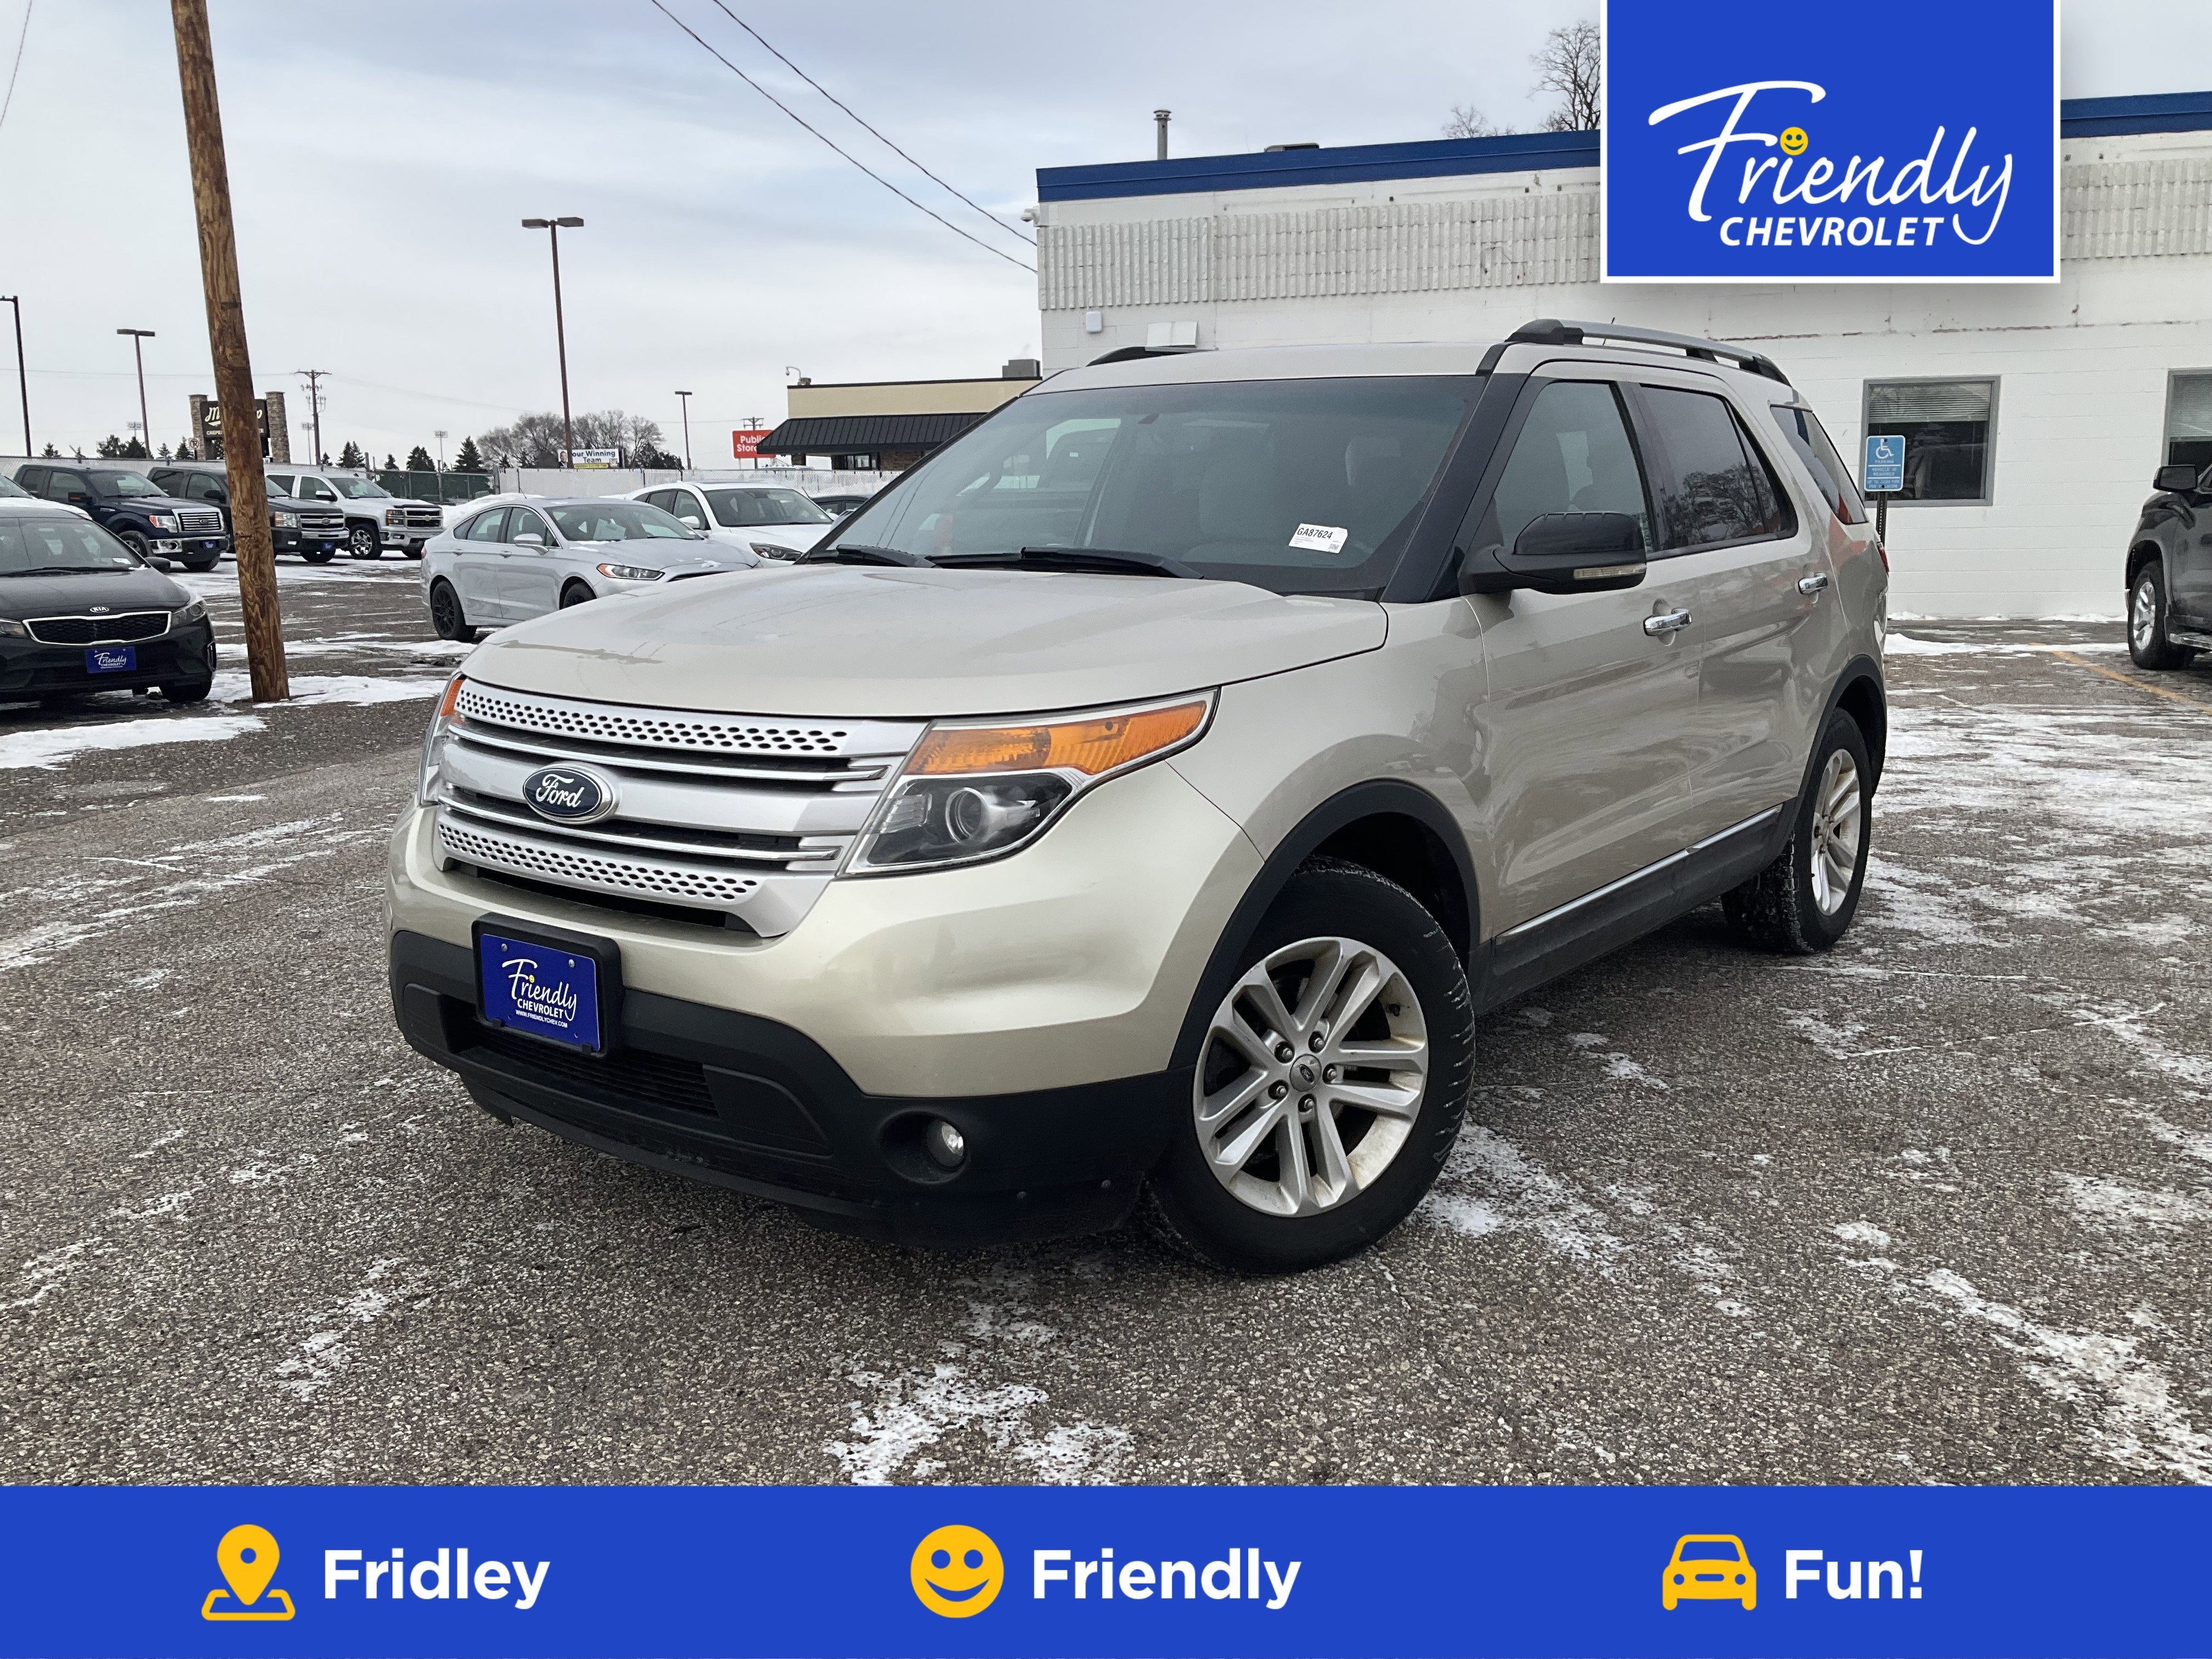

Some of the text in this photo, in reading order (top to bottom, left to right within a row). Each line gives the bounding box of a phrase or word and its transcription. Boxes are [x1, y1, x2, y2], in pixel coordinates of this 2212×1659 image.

[737, 444, 757, 452] Stor
[1297, 528, 1333, 539] GA87624
[94, 652, 127, 665] Friendly
[535, 774, 585, 808] Ford
[502, 958, 577, 1021] Friendly
[517, 998, 563, 1019] CHEVROLET
[516, 1009, 568, 1028] WWW.FRIENDLYCHEV.COM
